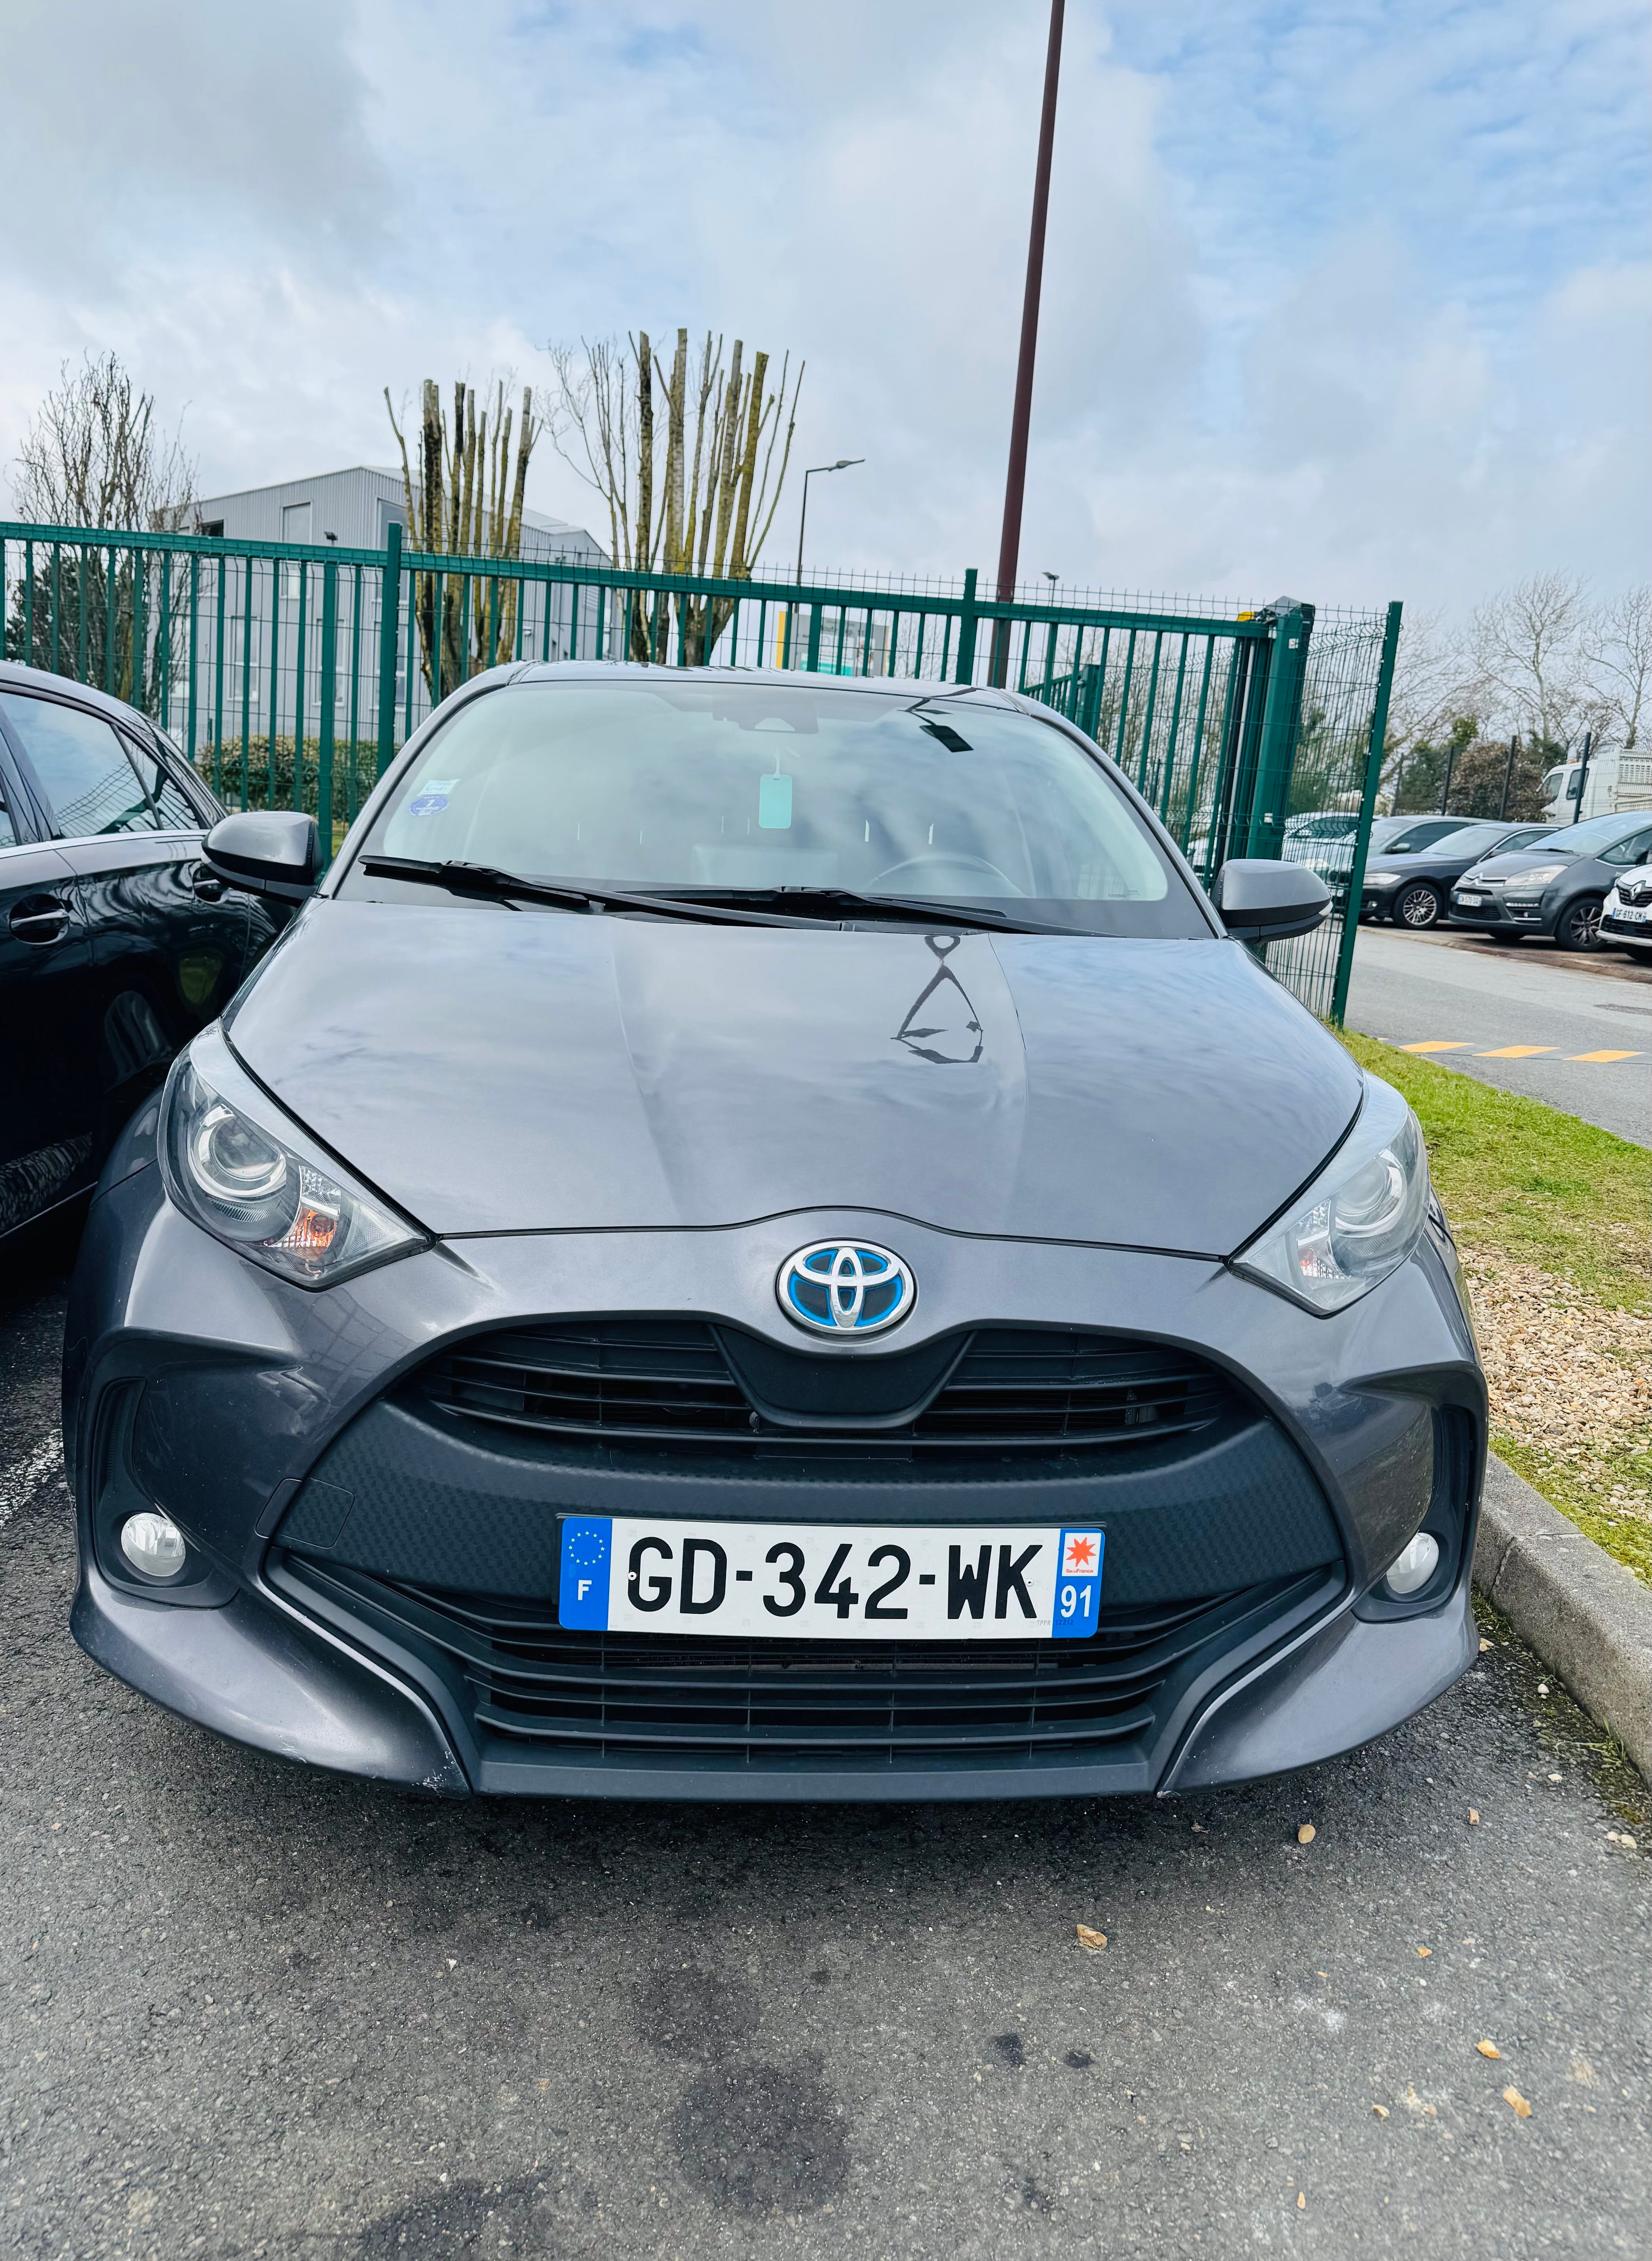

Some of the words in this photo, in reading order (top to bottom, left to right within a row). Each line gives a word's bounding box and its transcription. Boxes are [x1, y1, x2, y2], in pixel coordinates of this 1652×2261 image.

[577, 1580, 592, 1600] F
[628, 1537, 1043, 1619] GD-342-WK
[1061, 1585, 1091, 1617] 91
